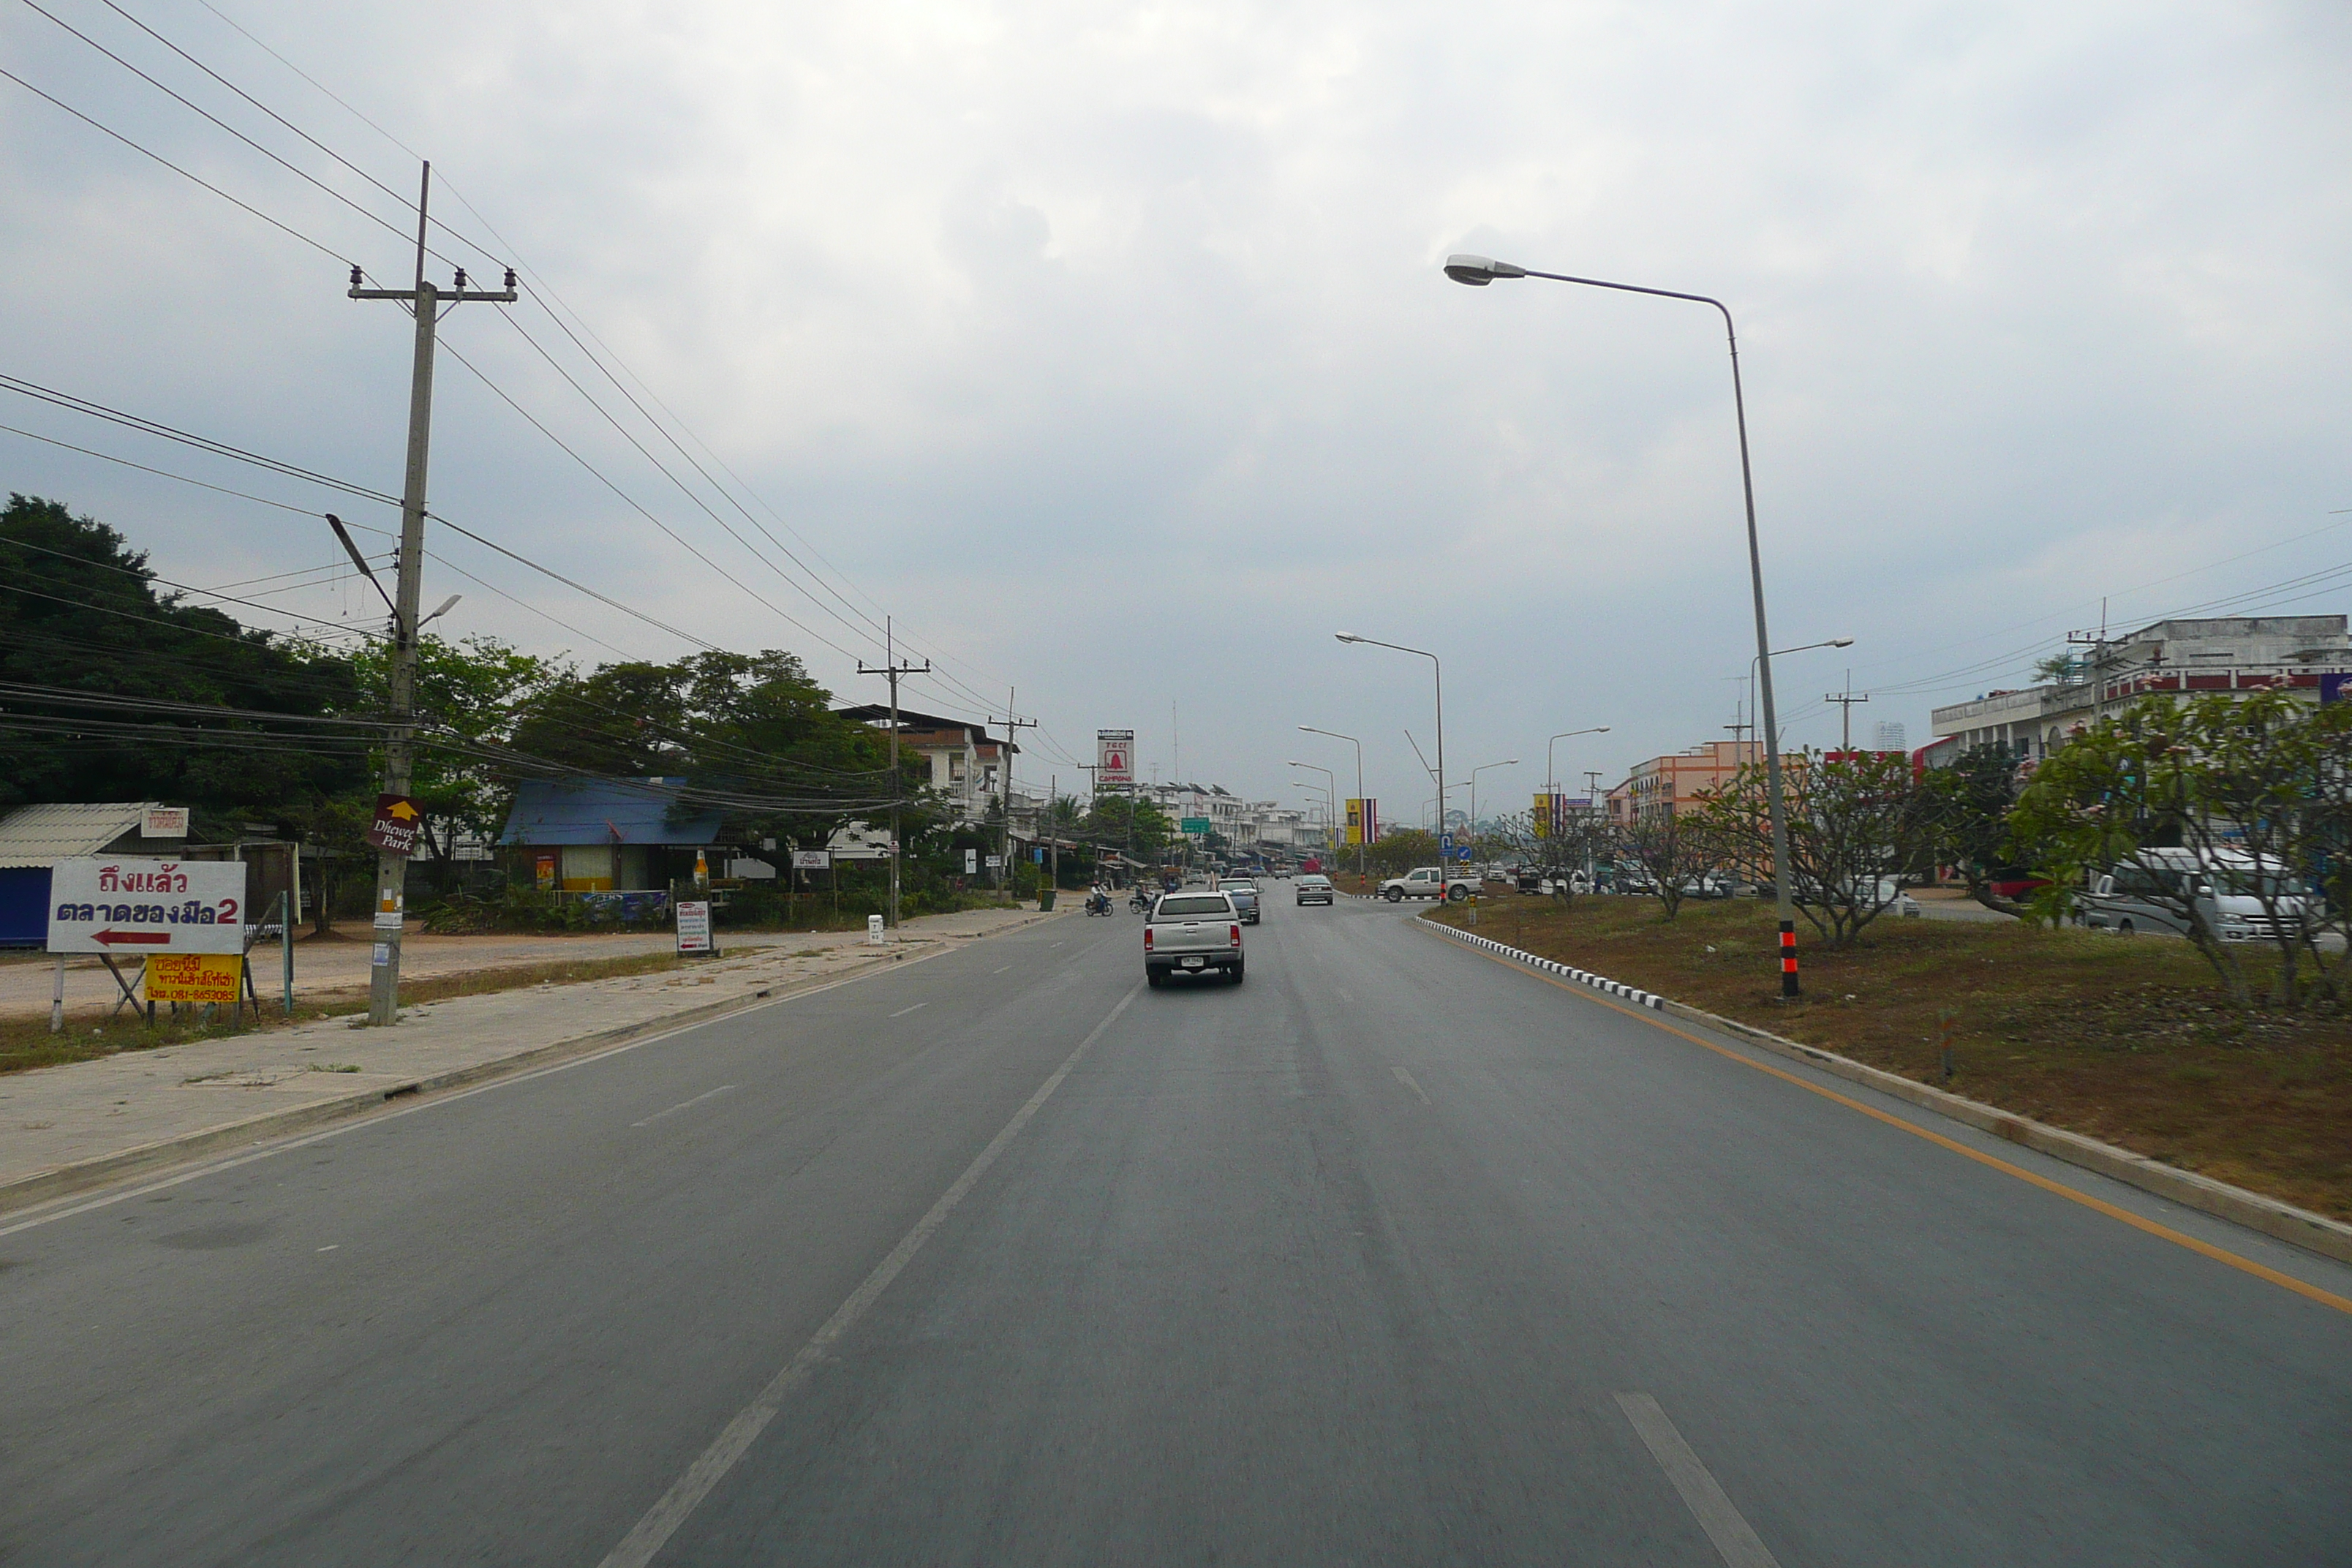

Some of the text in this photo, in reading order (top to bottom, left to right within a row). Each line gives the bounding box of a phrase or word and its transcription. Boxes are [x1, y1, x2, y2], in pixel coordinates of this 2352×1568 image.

[381, 834, 412, 851] Park
[99, 864, 188, 893] ถึงแล้ว
